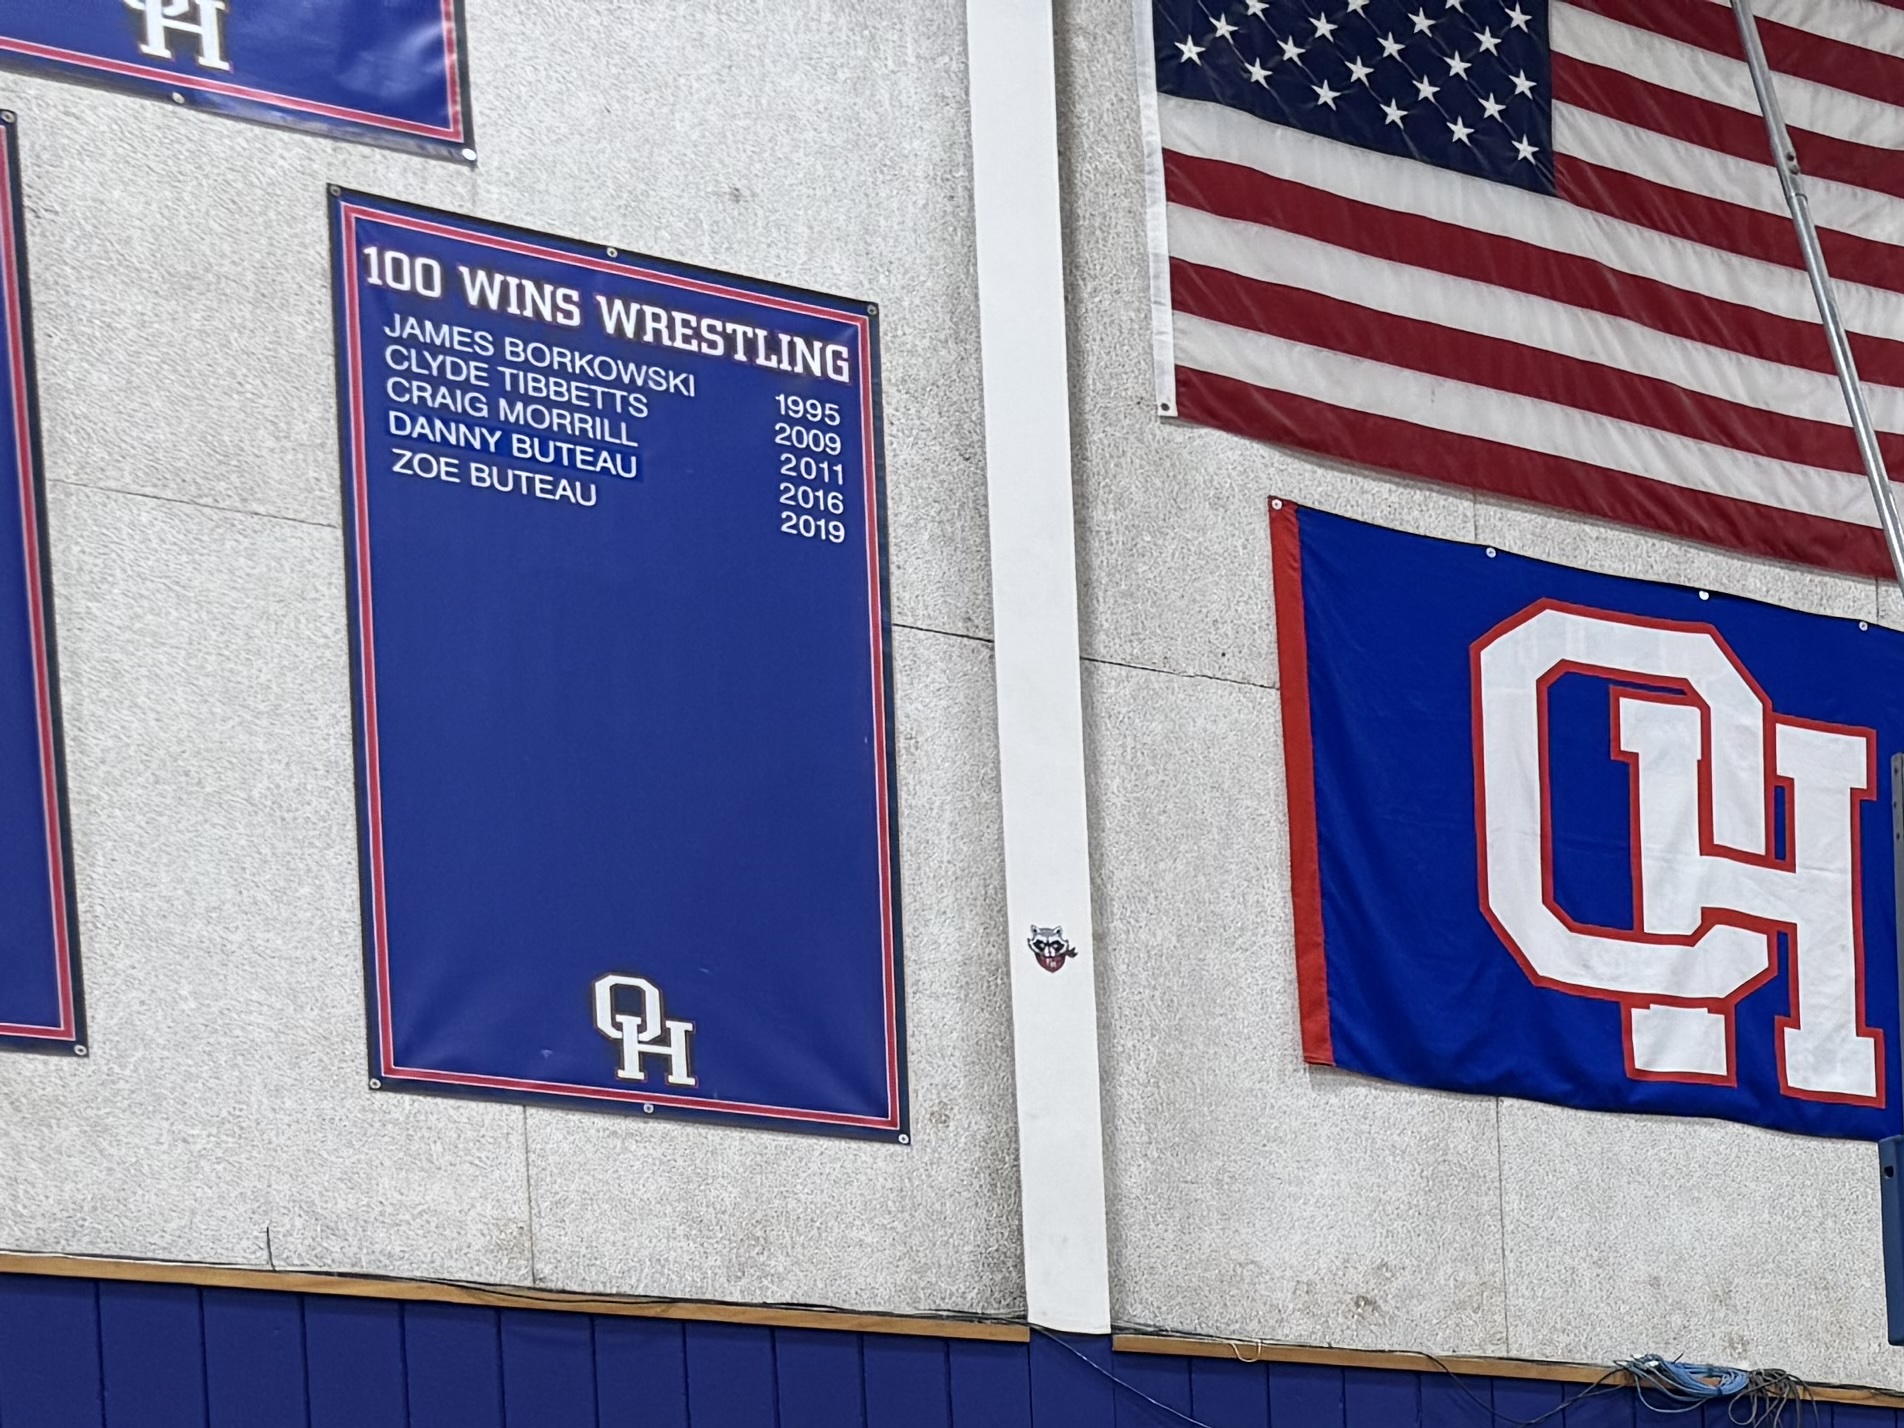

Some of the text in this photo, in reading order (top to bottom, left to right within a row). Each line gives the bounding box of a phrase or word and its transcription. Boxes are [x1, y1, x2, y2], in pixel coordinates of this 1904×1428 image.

[124, 0, 232, 71] H
[364, 246, 851, 383] 100 WINS WRESTLING
[384, 314, 841, 426] JAMES BORKOWSKI 1995
[385, 345, 841, 455] CLYDE TIBBETTS 2009
[386, 377, 843, 485] CRAIG MORRILL 2011
[389, 411, 844, 514] DANNY BUTEAU 2016
[392, 449, 845, 543] ZOE BUTEAU 2019
[1470, 598, 1885, 1107] OH
[593, 973, 696, 1087] OH
